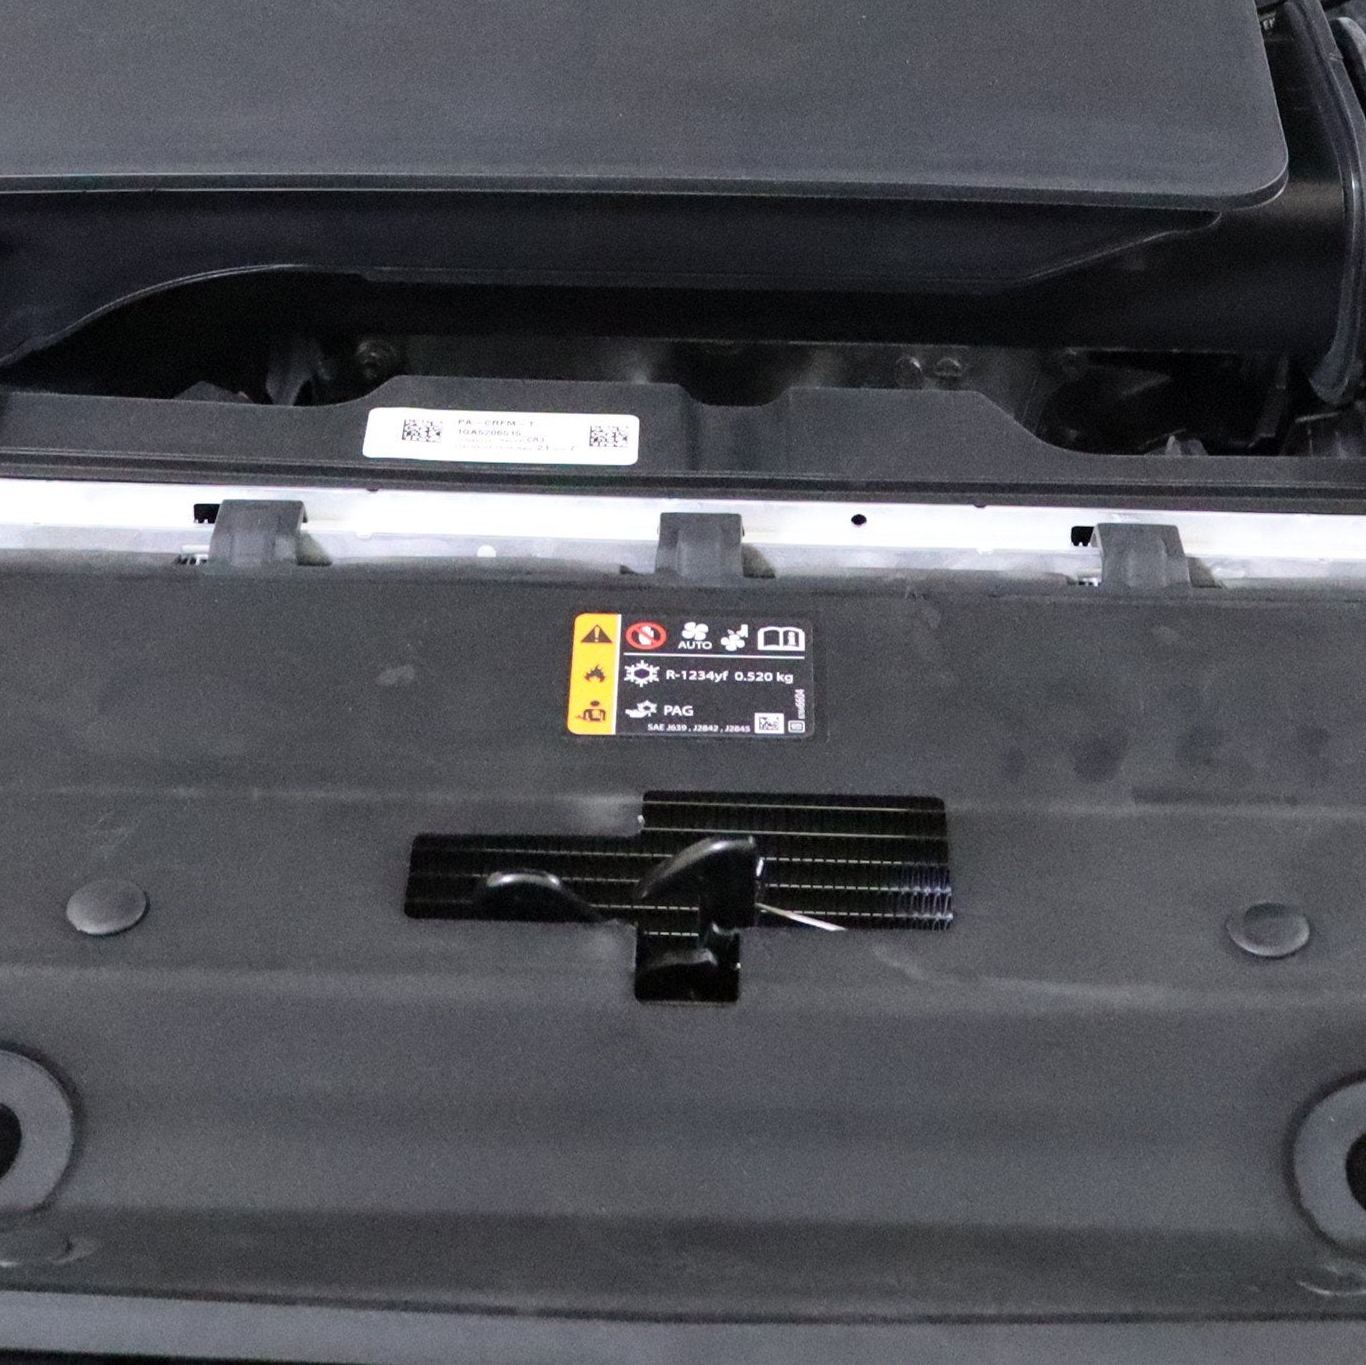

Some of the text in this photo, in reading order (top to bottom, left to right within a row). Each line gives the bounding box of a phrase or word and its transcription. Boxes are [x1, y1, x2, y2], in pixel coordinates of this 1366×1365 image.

[678, 640, 712, 650] AUTO
[666, 669, 794, 684] R-1234yf 0.520 kg
[663, 705, 694, 716] PAG
[647, 723, 665, 731] SAE
